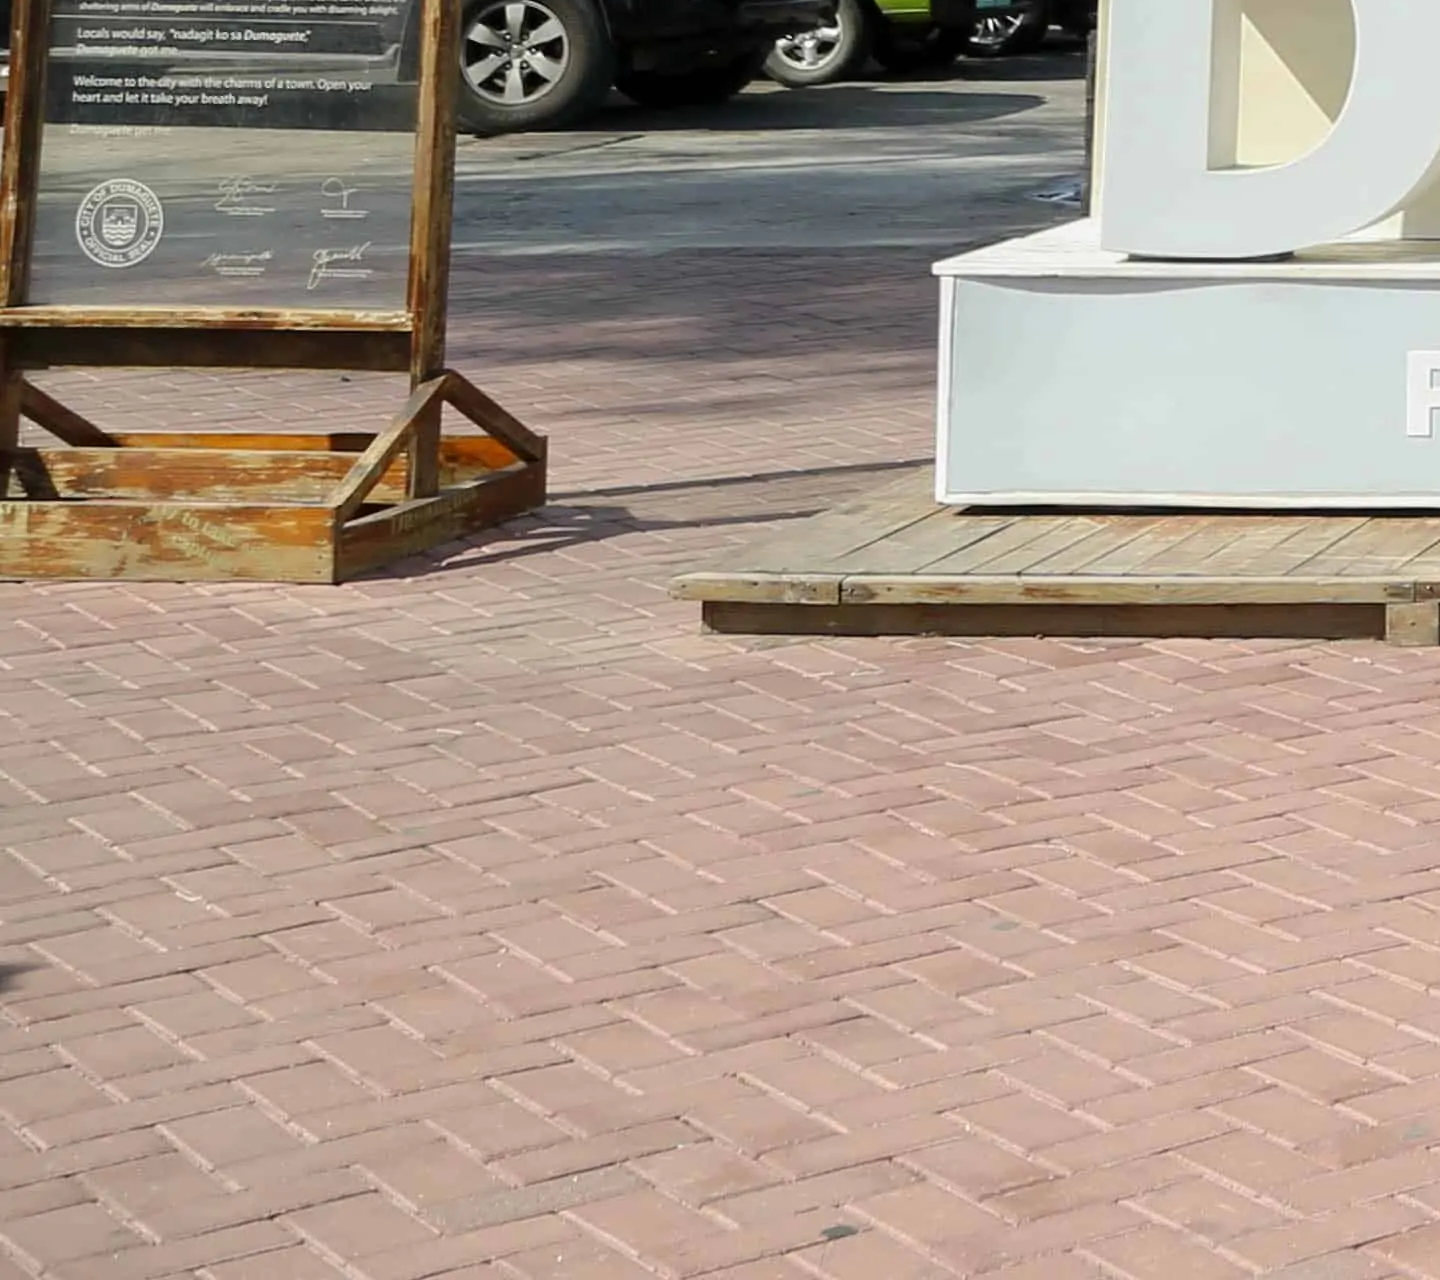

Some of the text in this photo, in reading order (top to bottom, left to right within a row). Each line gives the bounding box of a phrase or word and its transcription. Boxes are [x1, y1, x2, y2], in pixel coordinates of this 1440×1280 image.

[77, 27, 110, 40] Locals
[112, 28, 145, 40] would
[74, 75, 123, 88] Welcome
[125, 77, 136, 88] to
[138, 76, 156, 88] the
[179, 77, 202, 88] with
[205, 78, 222, 88] the
[224, 78, 262, 89] charms
[264, 78, 276, 88] of
[317, 79, 346, 92] Open
[349, 81, 372, 92] your
[102, 92, 124, 104] and
[126, 93, 140, 104] let
[142, 93, 148, 104] it
[151, 93, 173, 104] take
[175, 95, 200, 106] your
[201, 94, 235, 104] breath
[80, 184, 160, 227] CITY OF DUMAGUETE
[84, 238, 126, 262] OFFICIAL
